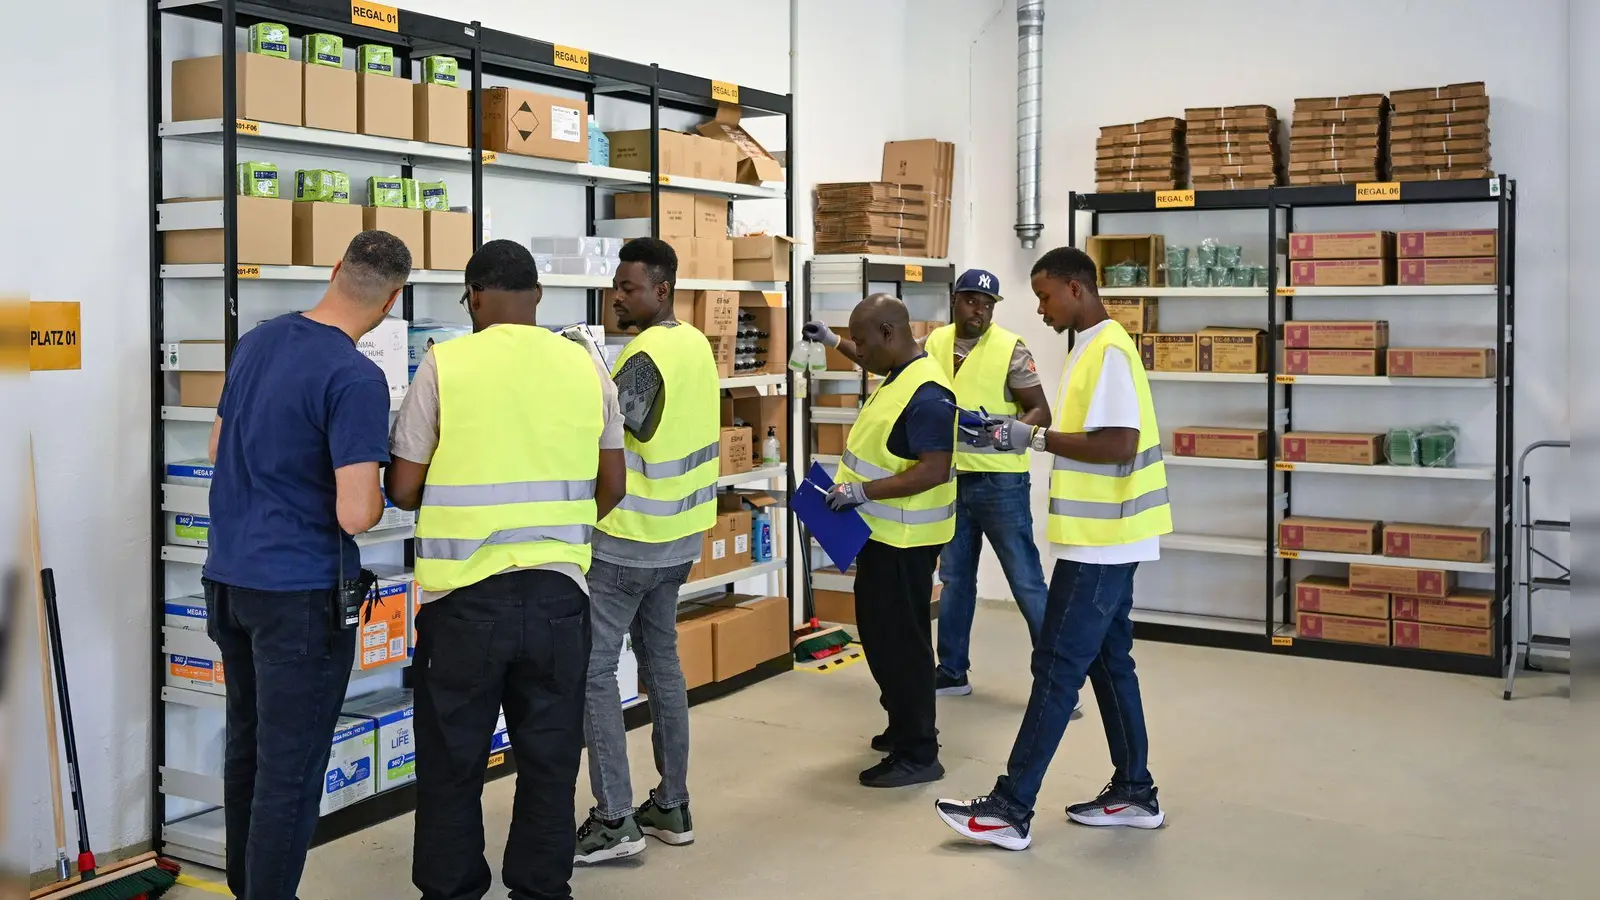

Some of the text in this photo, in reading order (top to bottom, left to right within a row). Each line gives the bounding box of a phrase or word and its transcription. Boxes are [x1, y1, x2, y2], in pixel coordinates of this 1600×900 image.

[353, 6, 396, 24] REGAL 01
[555, 50, 588, 66] REGAL 02
[713, 85, 731, 97] REGAL
[1357, 187, 1400, 196] REGAL 06
[1157, 194, 1194, 203] REGAL 05
[30, 330, 77, 346] PLATZ 01
[357, 341, 377, 350] NMAL-
[193, 469, 209, 477] MEGA
[187, 608, 202, 616] MEGA
[391, 734, 410, 749] LIFE
